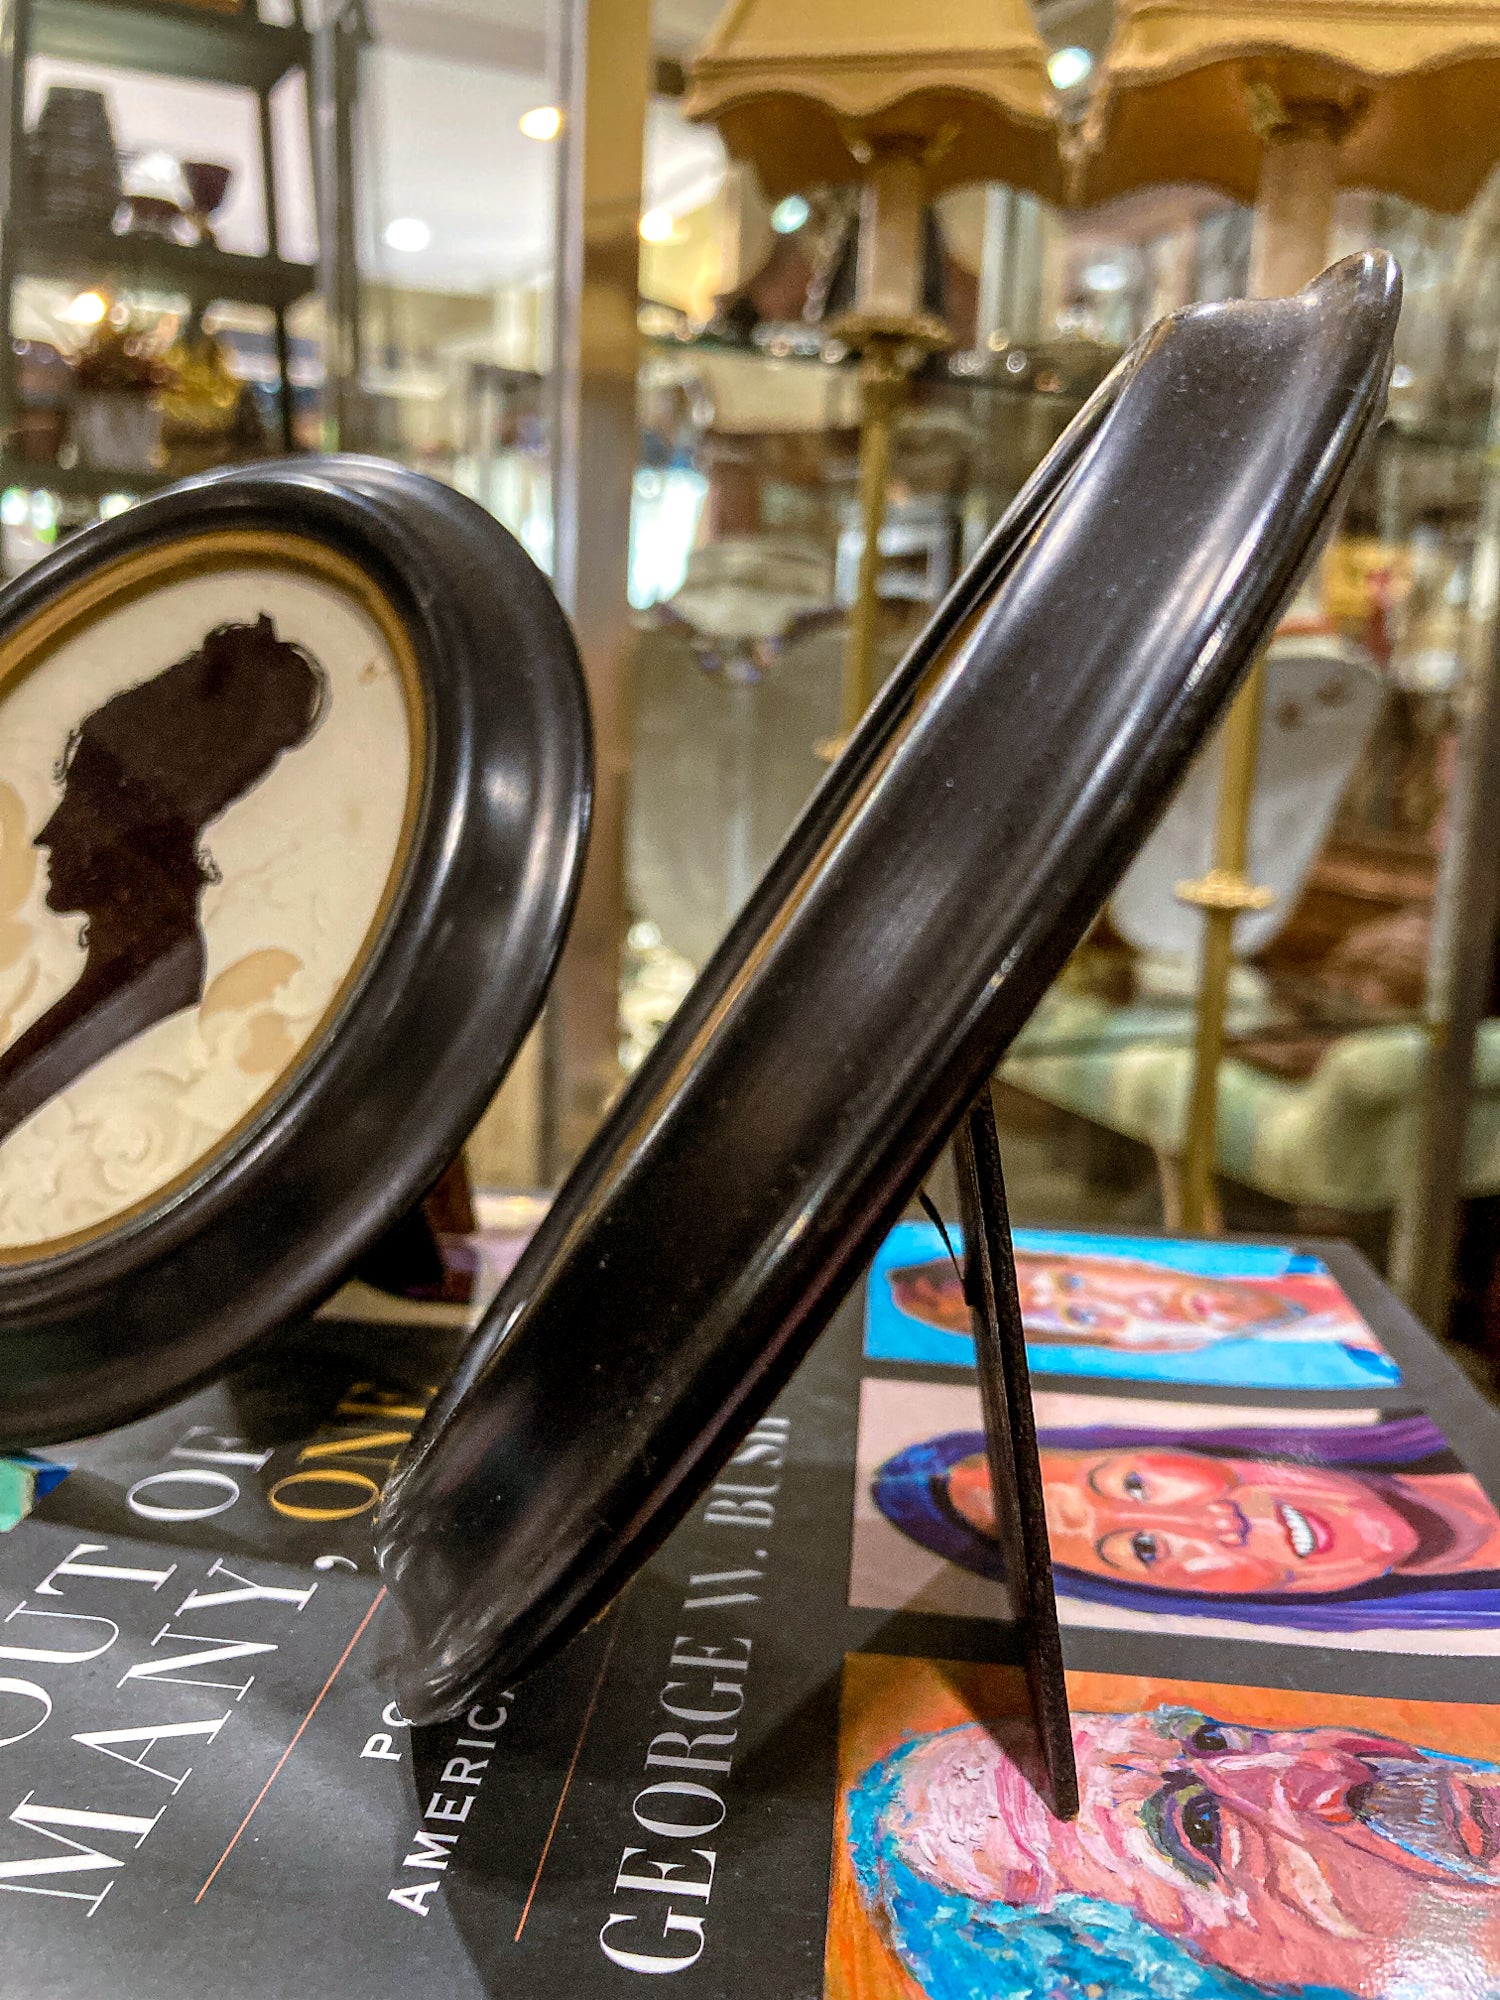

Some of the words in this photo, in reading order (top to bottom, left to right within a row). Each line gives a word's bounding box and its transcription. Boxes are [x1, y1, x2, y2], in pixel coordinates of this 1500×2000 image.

[126, 1426, 275, 1521] OF
[0, 1555, 358, 1917] MANY,
[388, 1690, 515, 1917] AMERIC
[600, 1636, 752, 1974] GEORGE
